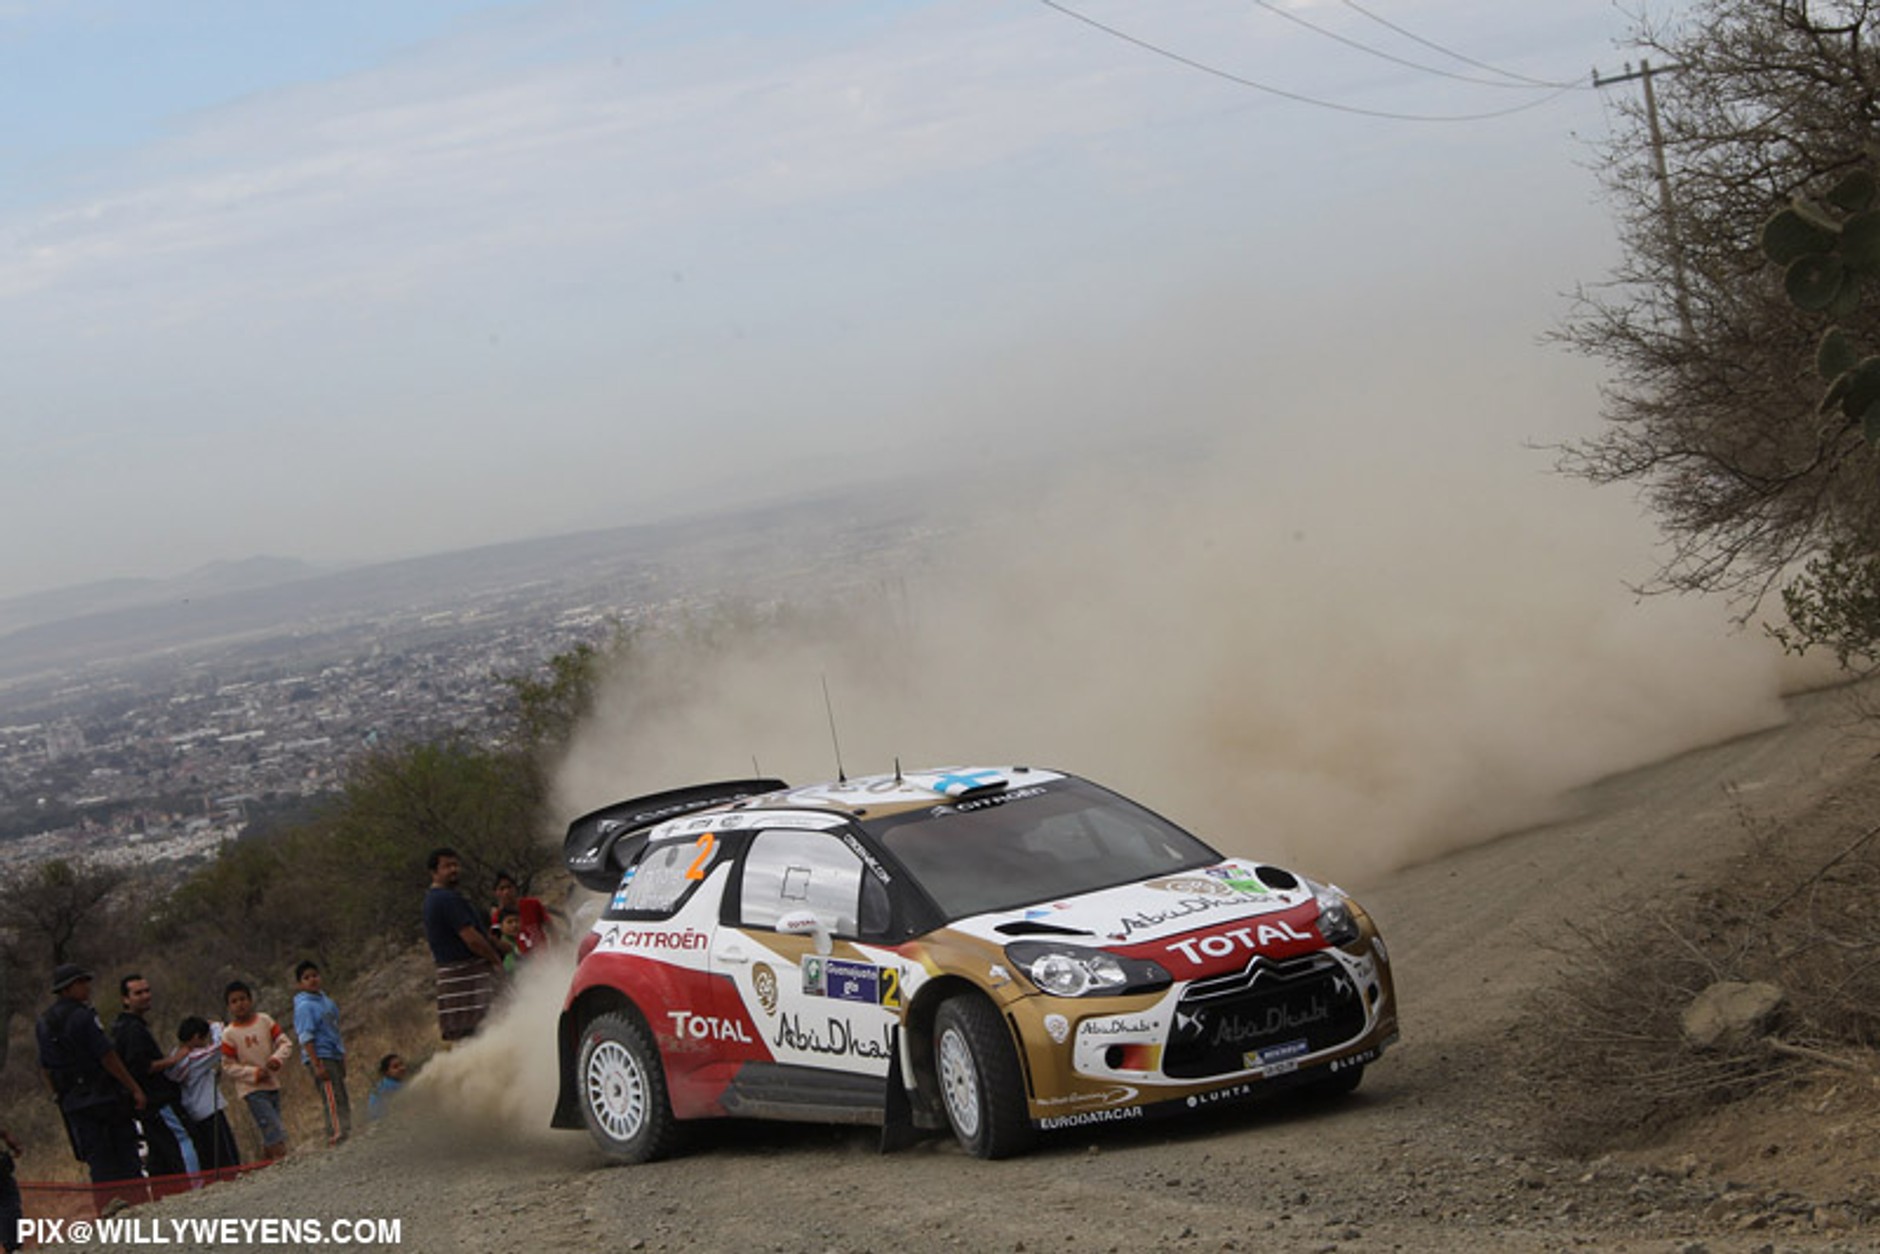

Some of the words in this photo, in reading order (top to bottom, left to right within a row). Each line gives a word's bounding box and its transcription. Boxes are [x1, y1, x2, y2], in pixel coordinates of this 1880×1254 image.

[685, 832, 715, 880] 2
[1165, 921, 1313, 964] TOTAL
[882, 968, 899, 1007] 2
[667, 1010, 753, 1044] TOTAL
[1040, 1106, 1143, 1129] EURODATACAR
